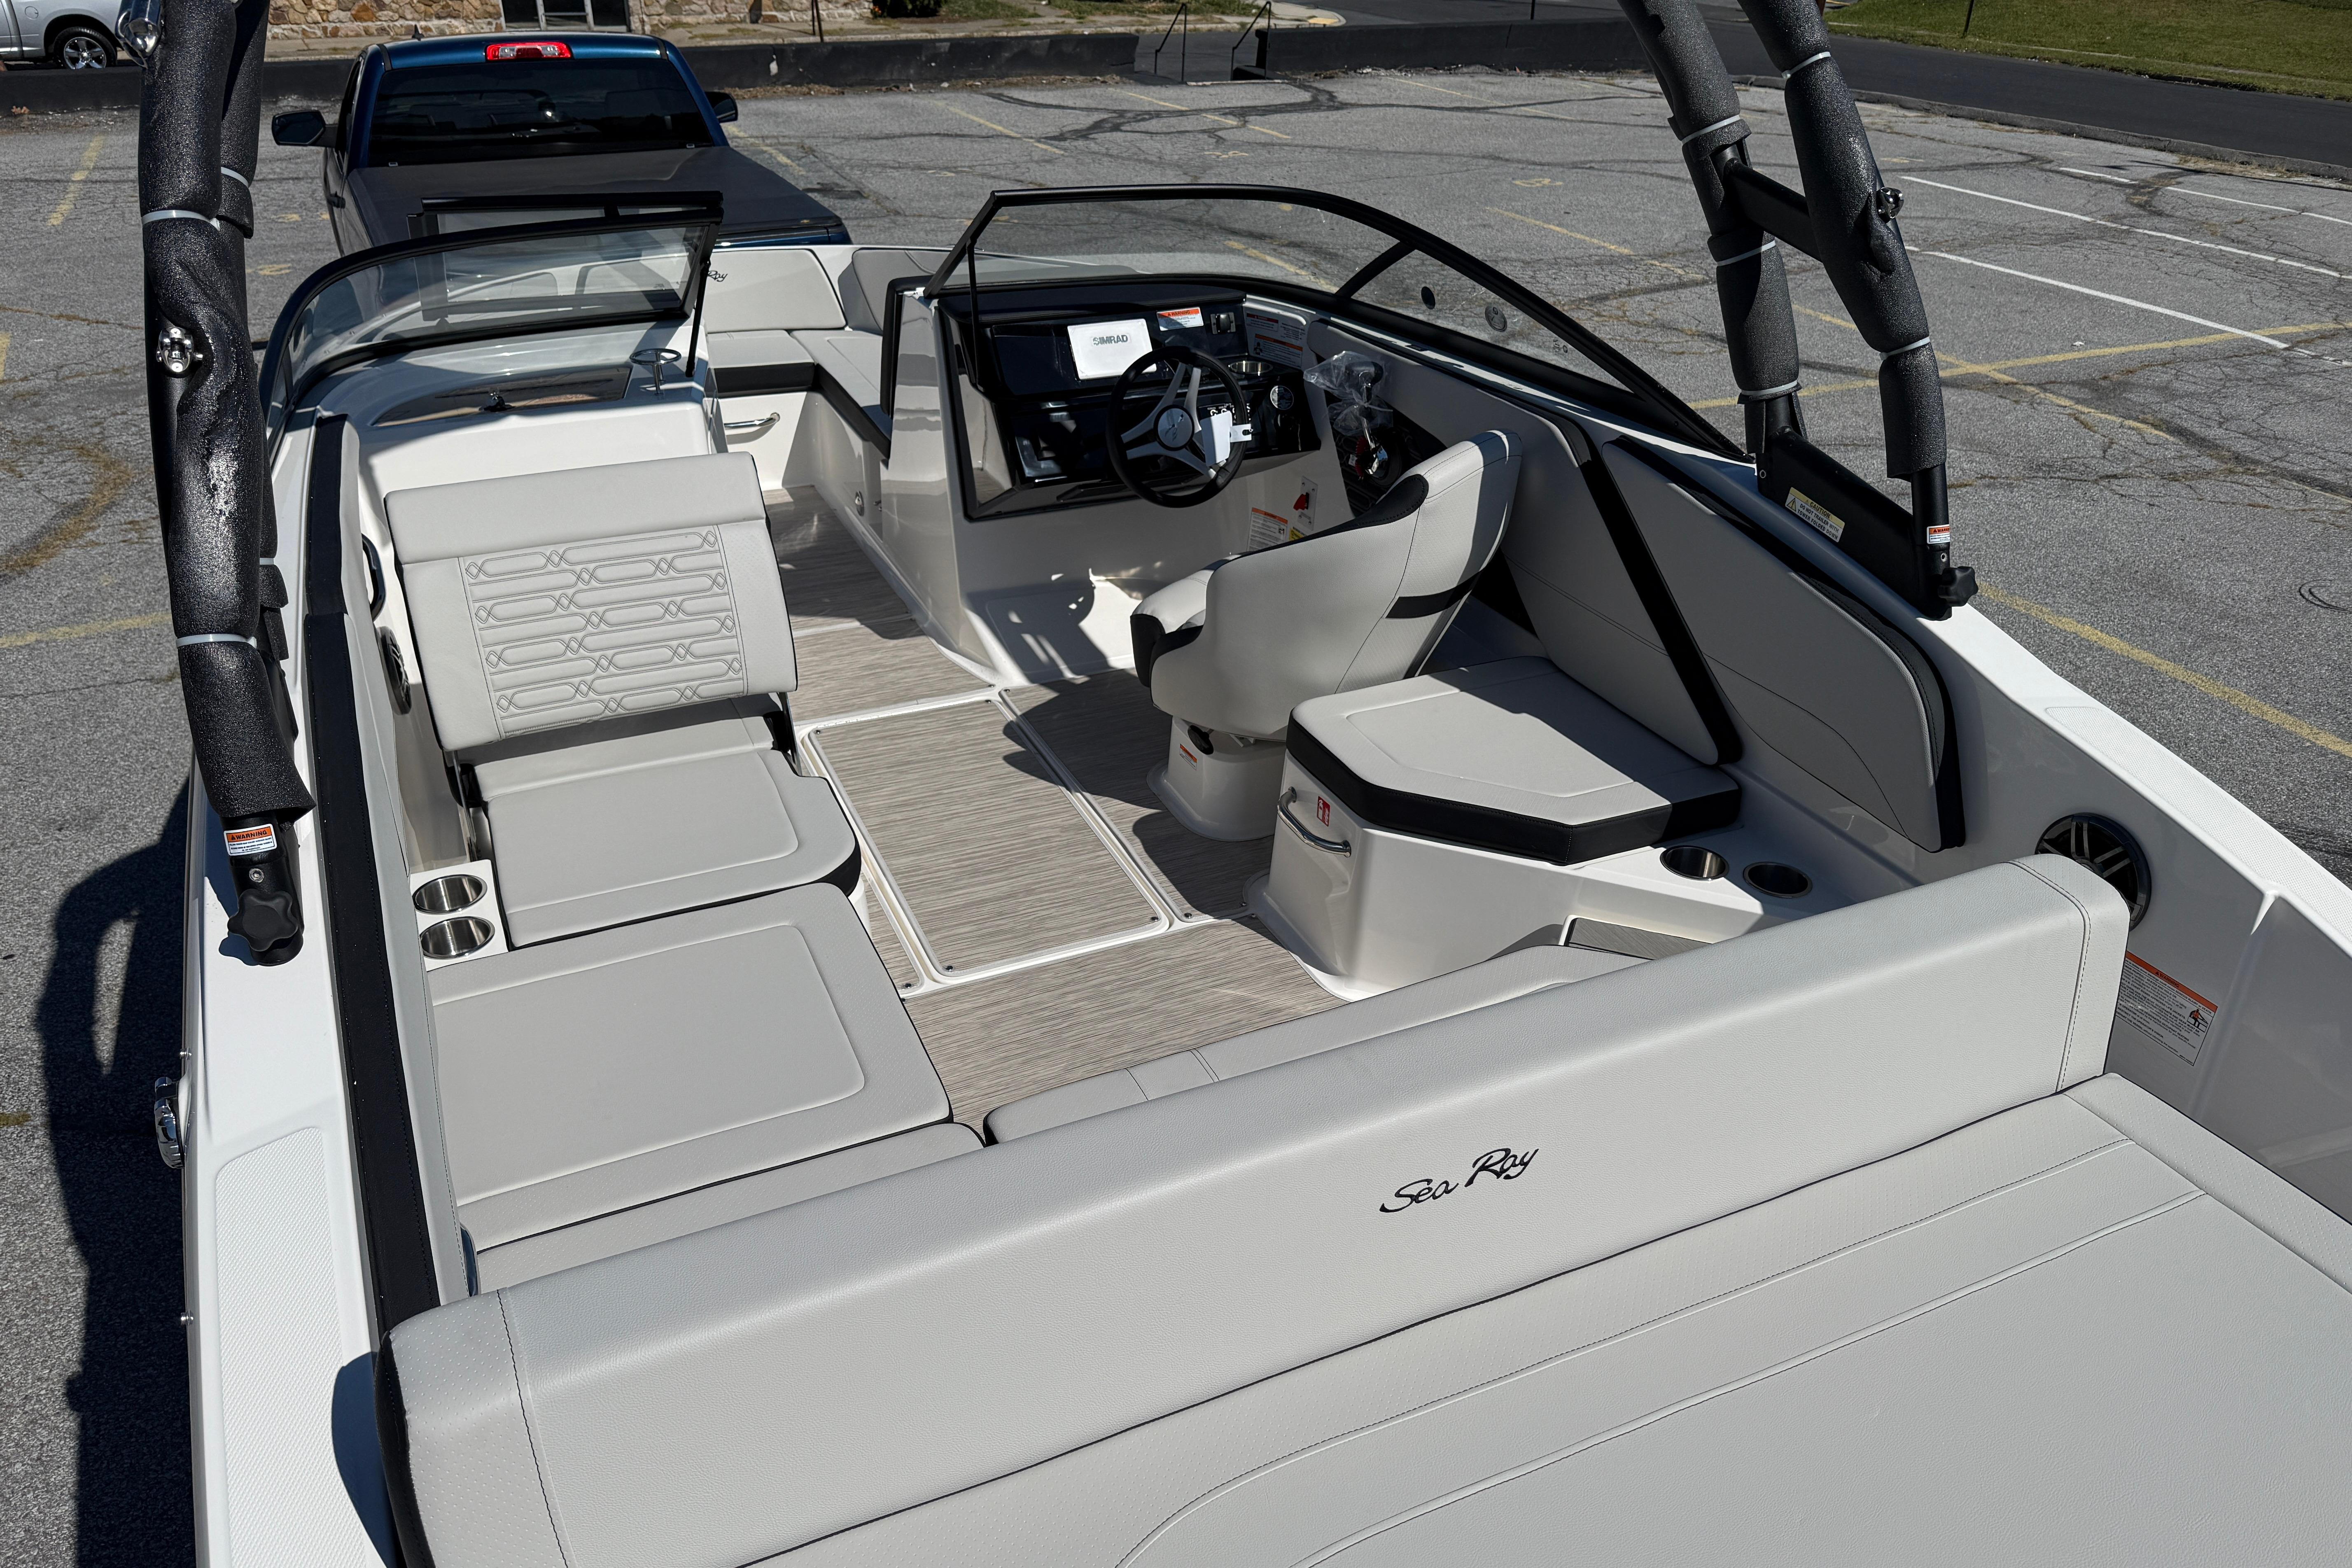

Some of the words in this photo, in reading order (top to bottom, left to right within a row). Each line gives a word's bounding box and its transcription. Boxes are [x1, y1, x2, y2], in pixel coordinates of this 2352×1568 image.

[707, 270, 728, 282] Ray
[1093, 335, 1128, 346] SIMRAD
[1810, 502, 1831, 519] CAUTION
[1797, 509, 1811, 521] TOWER
[1811, 519, 1826, 531] FOLDED
[1826, 530, 1838, 540] DOWN
[1813, 512, 1829, 525] TRAILER
[1829, 524, 1839, 533] WITH
[236, 830, 267, 840] WARNING
[1379, 1178, 1459, 1213] Sea
[1464, 1148, 1539, 1188] Ray
